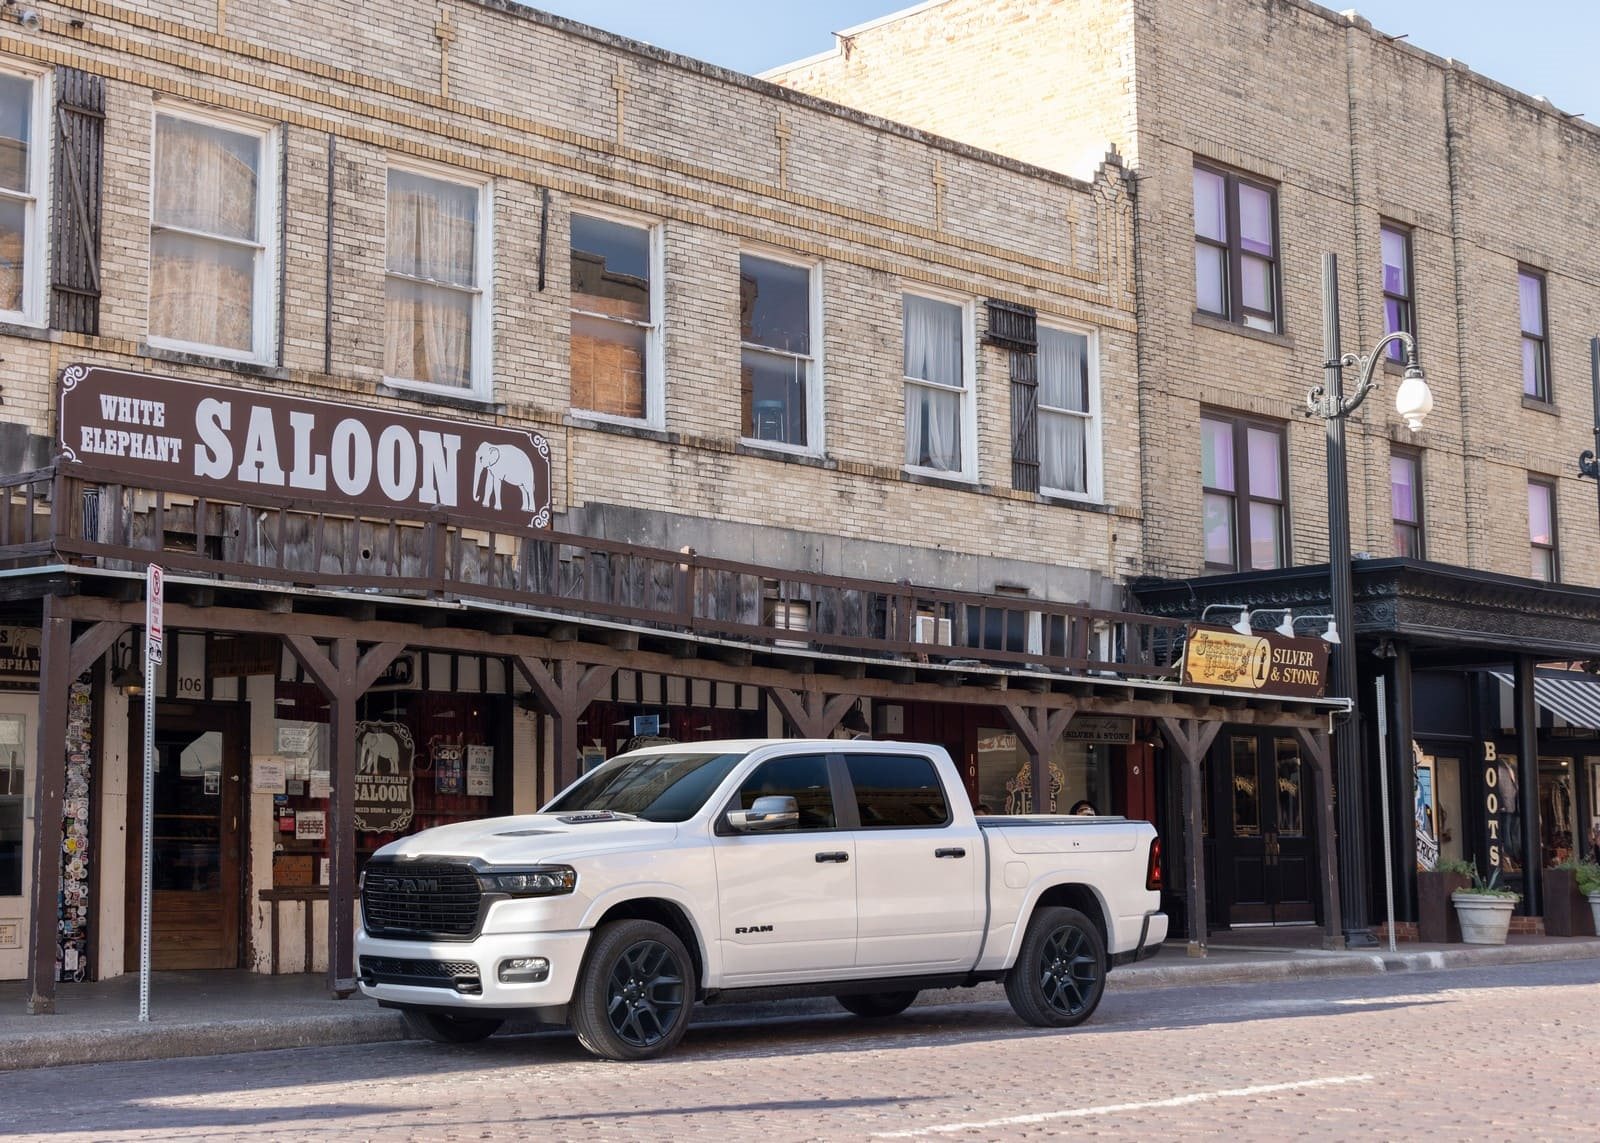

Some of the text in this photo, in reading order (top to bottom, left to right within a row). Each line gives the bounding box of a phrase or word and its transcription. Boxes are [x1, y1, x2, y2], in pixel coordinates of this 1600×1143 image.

[100, 393, 166, 429] WHITE
[80, 425, 182, 464] ELEPHANT
[193, 397, 462, 507] SALOON
[1272, 648, 1314, 667] SILVER
[179, 677, 202, 692] 106
[1270, 667, 1320, 686] & STONE
[354, 784, 408, 802] SALOON
[1484, 741, 1500, 866] BOOTS
[383, 878, 438, 893] RAM
[735, 924, 773, 934] RAM
